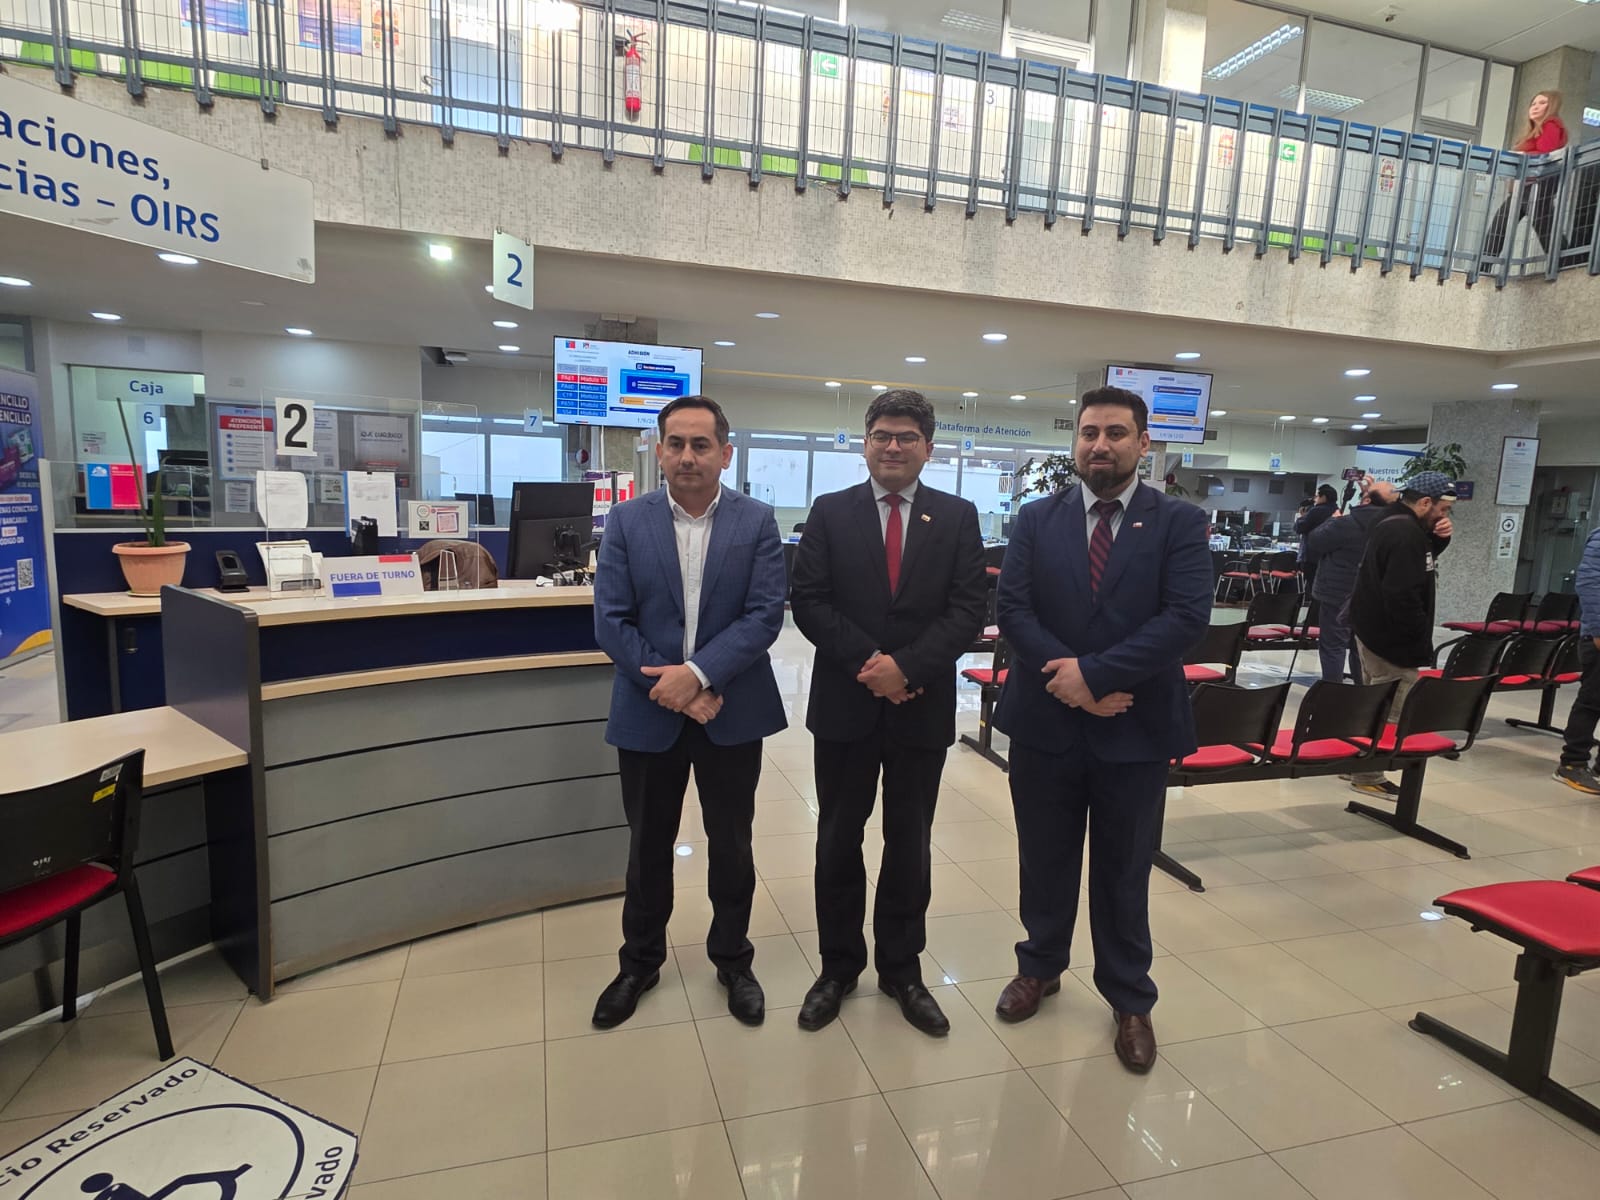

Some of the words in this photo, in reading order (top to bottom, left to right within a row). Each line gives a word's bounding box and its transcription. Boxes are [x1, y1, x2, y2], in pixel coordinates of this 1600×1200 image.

[130, 193, 220, 243] OIRS
[507, 253, 523, 288] 2
[129, 380, 164, 396] Caja
[143, 411, 154, 424] 6
[529, 415, 538, 426] 7
[283, 403, 308, 448] 2
[934, 421, 980, 434] Plataforma
[983, 424, 993, 434] de
[994, 425, 1031, 437] Atención
[838, 434, 846, 444] 8
[965, 440, 972, 450] 9
[1184, 453, 1192, 463] 11
[1271, 458, 1280, 468] 12
[330, 572, 364, 581] FUERA
[366, 571, 380, 580] DE
[382, 570, 415, 579] TURNO
[45, 1067, 199, 1154] Reservado
